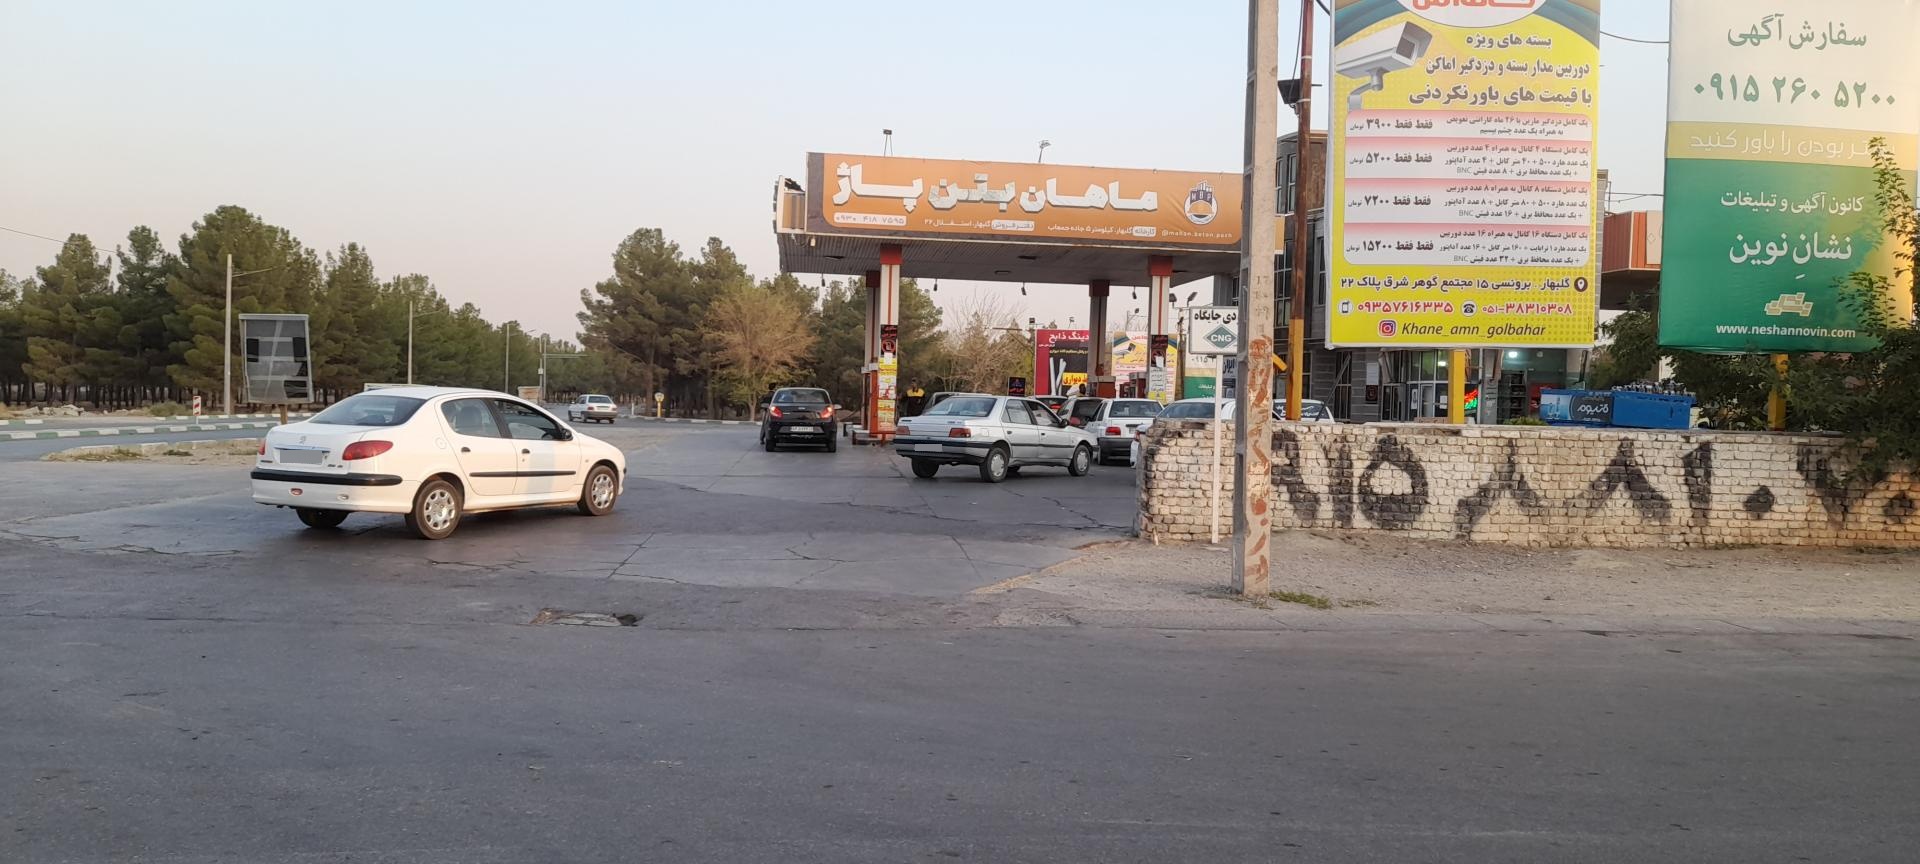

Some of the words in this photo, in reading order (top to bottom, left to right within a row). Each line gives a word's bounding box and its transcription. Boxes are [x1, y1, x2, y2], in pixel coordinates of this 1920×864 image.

[1728, 14, 1784, 47] آگهی
[1788, 20, 1867, 50] سفارش
[1466, 33, 1494, 48] ویژه
[1497, 33, 1522, 48] های
[1526, 35, 1552, 48] بسته
[1426, 57, 1456, 74] اماکن
[1459, 58, 1494, 76] دزدگیر
[1498, 64, 1504, 76] و
[1506, 60, 1528, 76] بسته
[1531, 59, 1553, 77] مدار
[1556, 63, 1590, 78] دوربین
[1504, 86, 1535, 106] های
[1539, 88, 1578, 107] قیمت
[1582, 88, 1592, 107] با
[1694, 72, 1760, 102] ۰۹۱۵
[1772, 76, 1821, 104] ۲۶۰
[1834, 80, 1896, 109] ۵۲۰۰
[1366, 118, 1391, 130] ۳۹۰۰
[1394, 118, 1412, 130] فقط
[1416, 118, 1433, 130] فقط
[1690, 129, 1737, 152] کنید
[1742, 129, 1775, 155] باور
[1780, 130, 1791, 156] را
[1797, 139, 1844, 158] بودن
[1366, 152, 1390, 164] ۵۲۰۰
[1394, 152, 1412, 163] فقط
[1414, 152, 1432, 163] فقط
[832, 161, 923, 214] پاژ
[928, 173, 1016, 212] بتن
[1019, 177, 1158, 213] ماهان
[1364, 195, 1389, 206] ۷۲۰۰
[1392, 196, 1411, 206] فقط
[1414, 196, 1432, 206] فقط
[1720, 190, 1776, 212] تبلیغات
[1780, 198, 1788, 212] و
[1790, 192, 1826, 214] آگهی
[1828, 196, 1864, 216] کانون
[1362, 240, 1392, 252] ۱۵۲۰۰
[1394, 240, 1414, 251] فقط
[1416, 240, 1434, 251] فقط
[1729, 232, 1790, 266] نوین
[1341, 278, 1354, 288] ۲۲
[1357, 276, 1380, 291] پلاک
[1384, 276, 1408, 289] شرق
[1412, 276, 1438, 290] گوهر
[1440, 278, 1472, 292] مجتمع
[1476, 279, 1488, 289] ۱۵
[1492, 280, 1532, 290] برونسی
[1542, 278, 1570, 290] گلبهار
[1358, 301, 1454, 313] ۰۹۳۵۷۶۱۶۳۳۵
[1194, 310, 1222, 324] جایگاه
[1222, 312, 1236, 324] دی
[1068, 331, 1090, 342] دینگ
[1402, 322, 1546, 338] Khane_amn_golbahar
[1716, 324, 1856, 338] www.neshannovin.com
[1210, 334, 1232, 342] CNG
